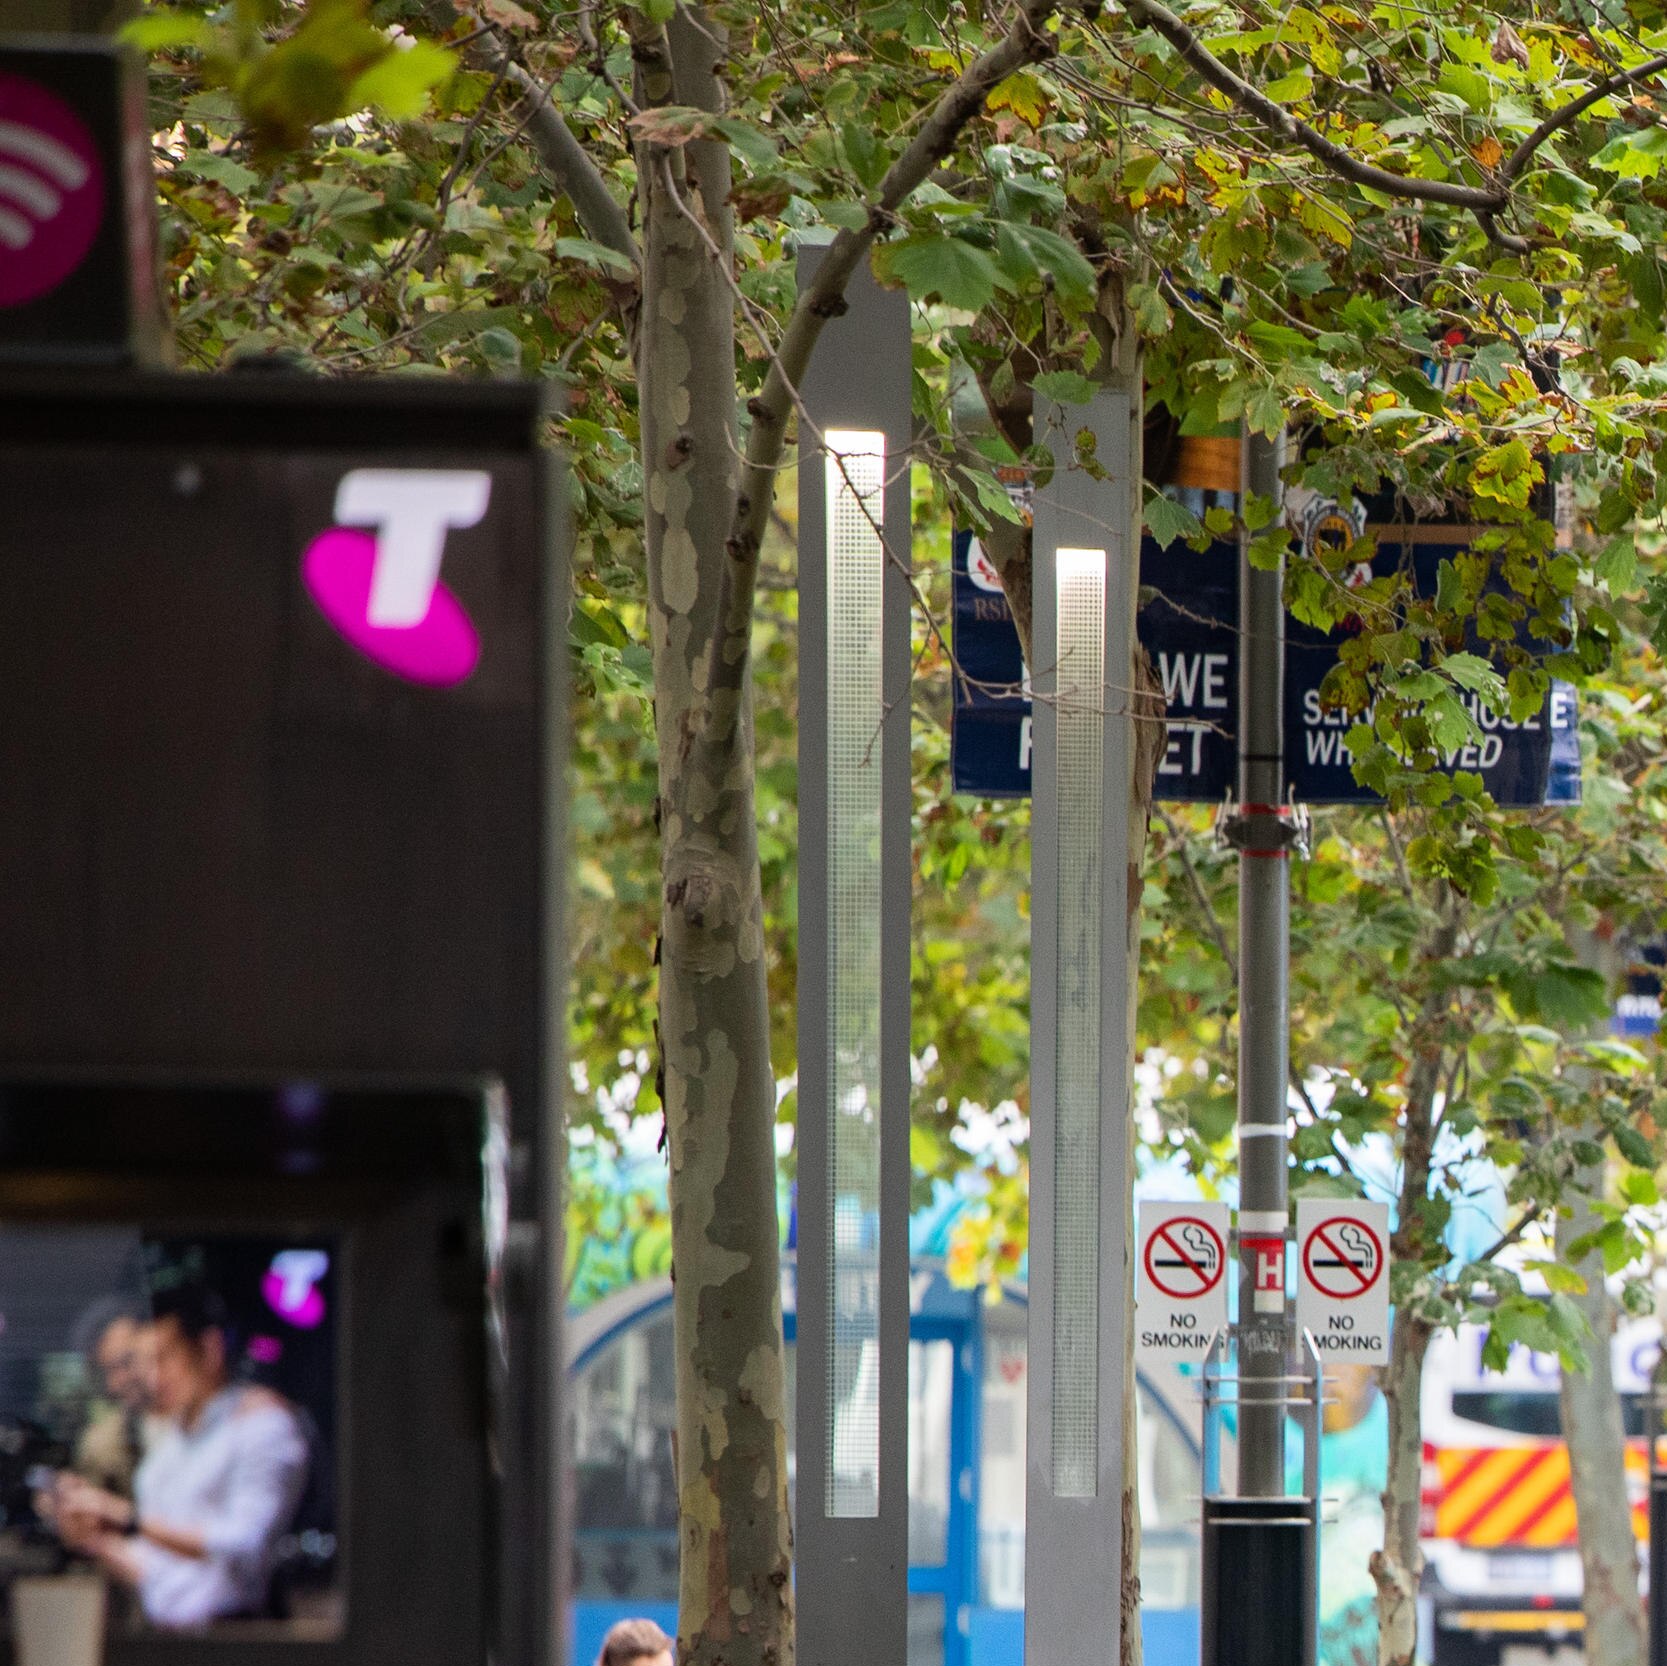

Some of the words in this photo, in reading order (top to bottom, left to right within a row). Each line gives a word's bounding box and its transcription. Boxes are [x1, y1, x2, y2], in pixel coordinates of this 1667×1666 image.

[1158, 651, 1229, 708] WE
[1170, 1313, 1197, 1328] NO
[1328, 1315, 1355, 1330] NO
[1303, 1335, 1382, 1350] MOKING
